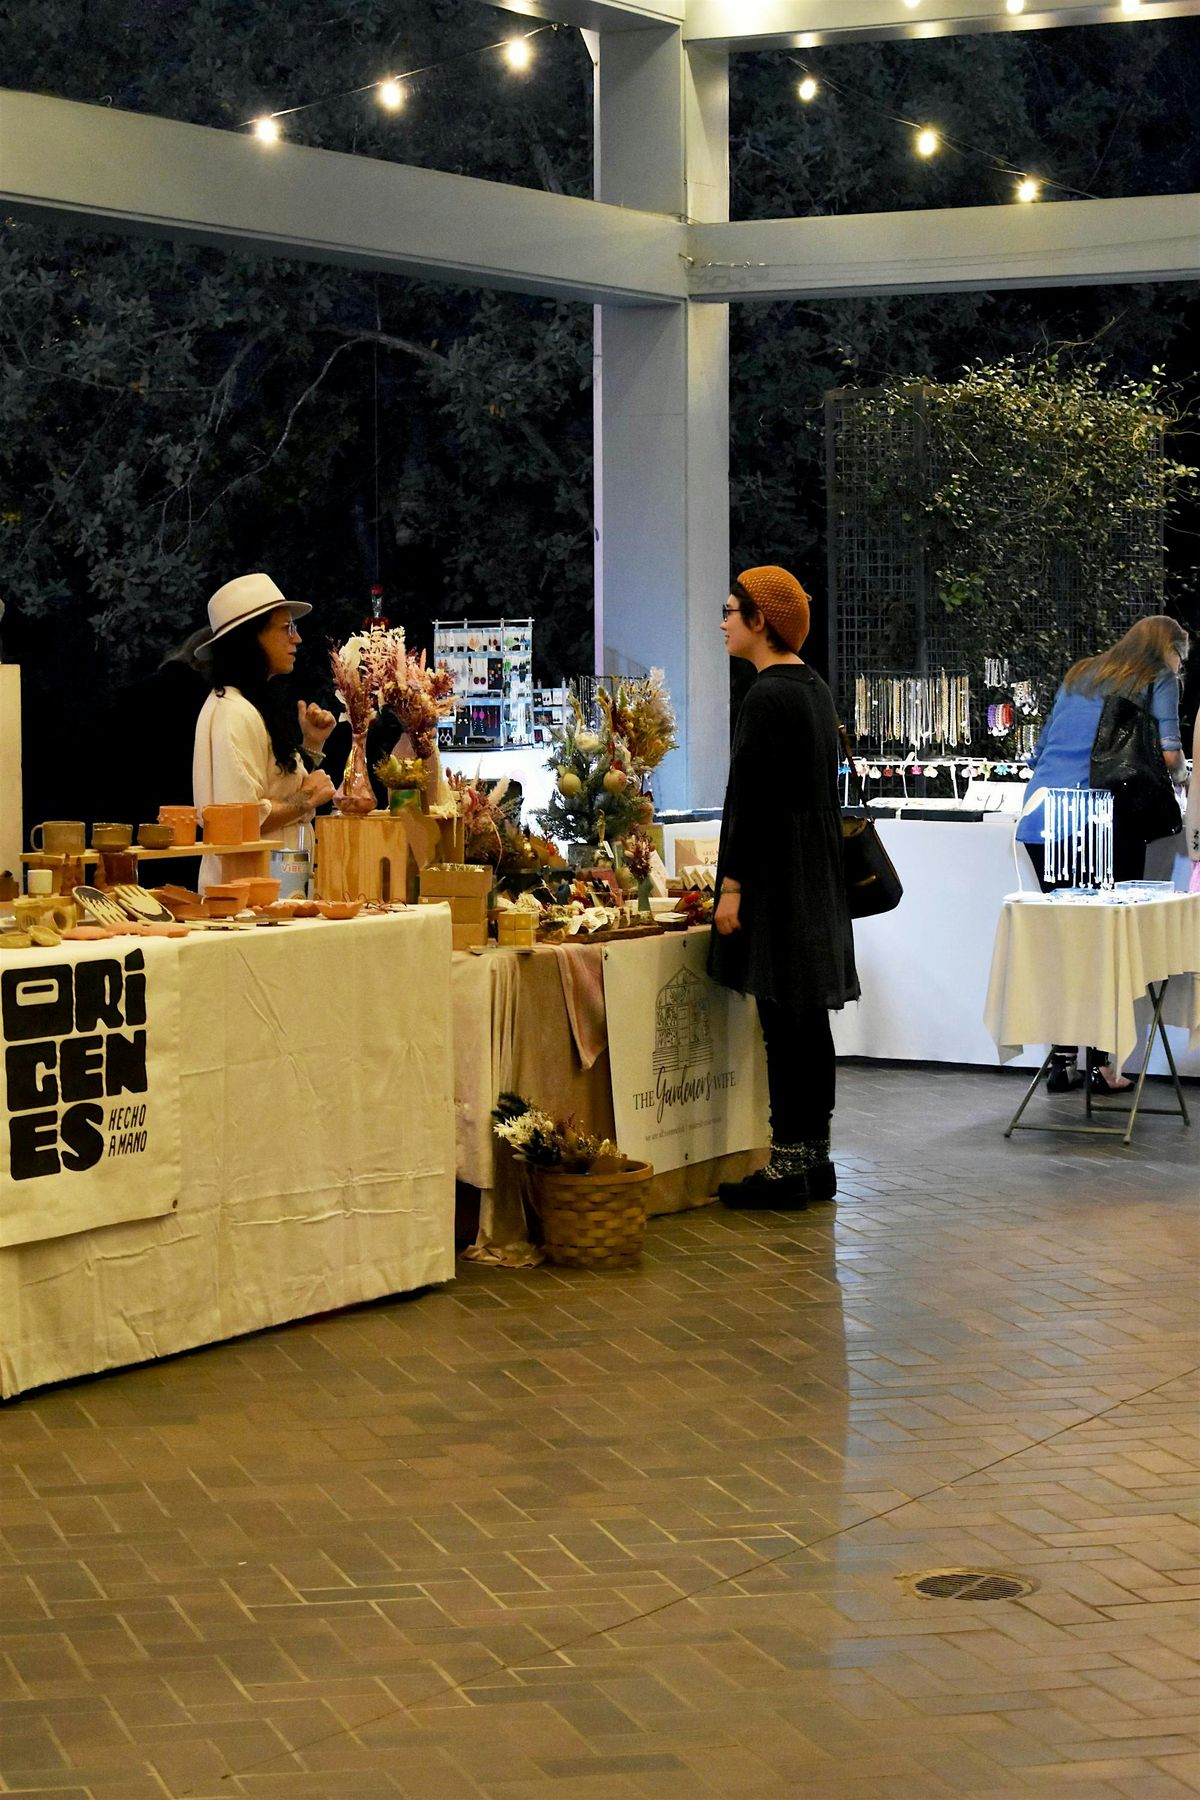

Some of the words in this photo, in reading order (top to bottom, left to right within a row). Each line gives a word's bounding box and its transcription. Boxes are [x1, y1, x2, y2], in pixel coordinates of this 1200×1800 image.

[632, 1090, 655, 1110] THE
[713, 1071, 737, 1090] WIFE
[108, 1104, 147, 1131] HECHO
[9, 1102, 104, 1181] ES
[108, 1135, 116, 1157] A
[117, 1130, 147, 1155] MANO
